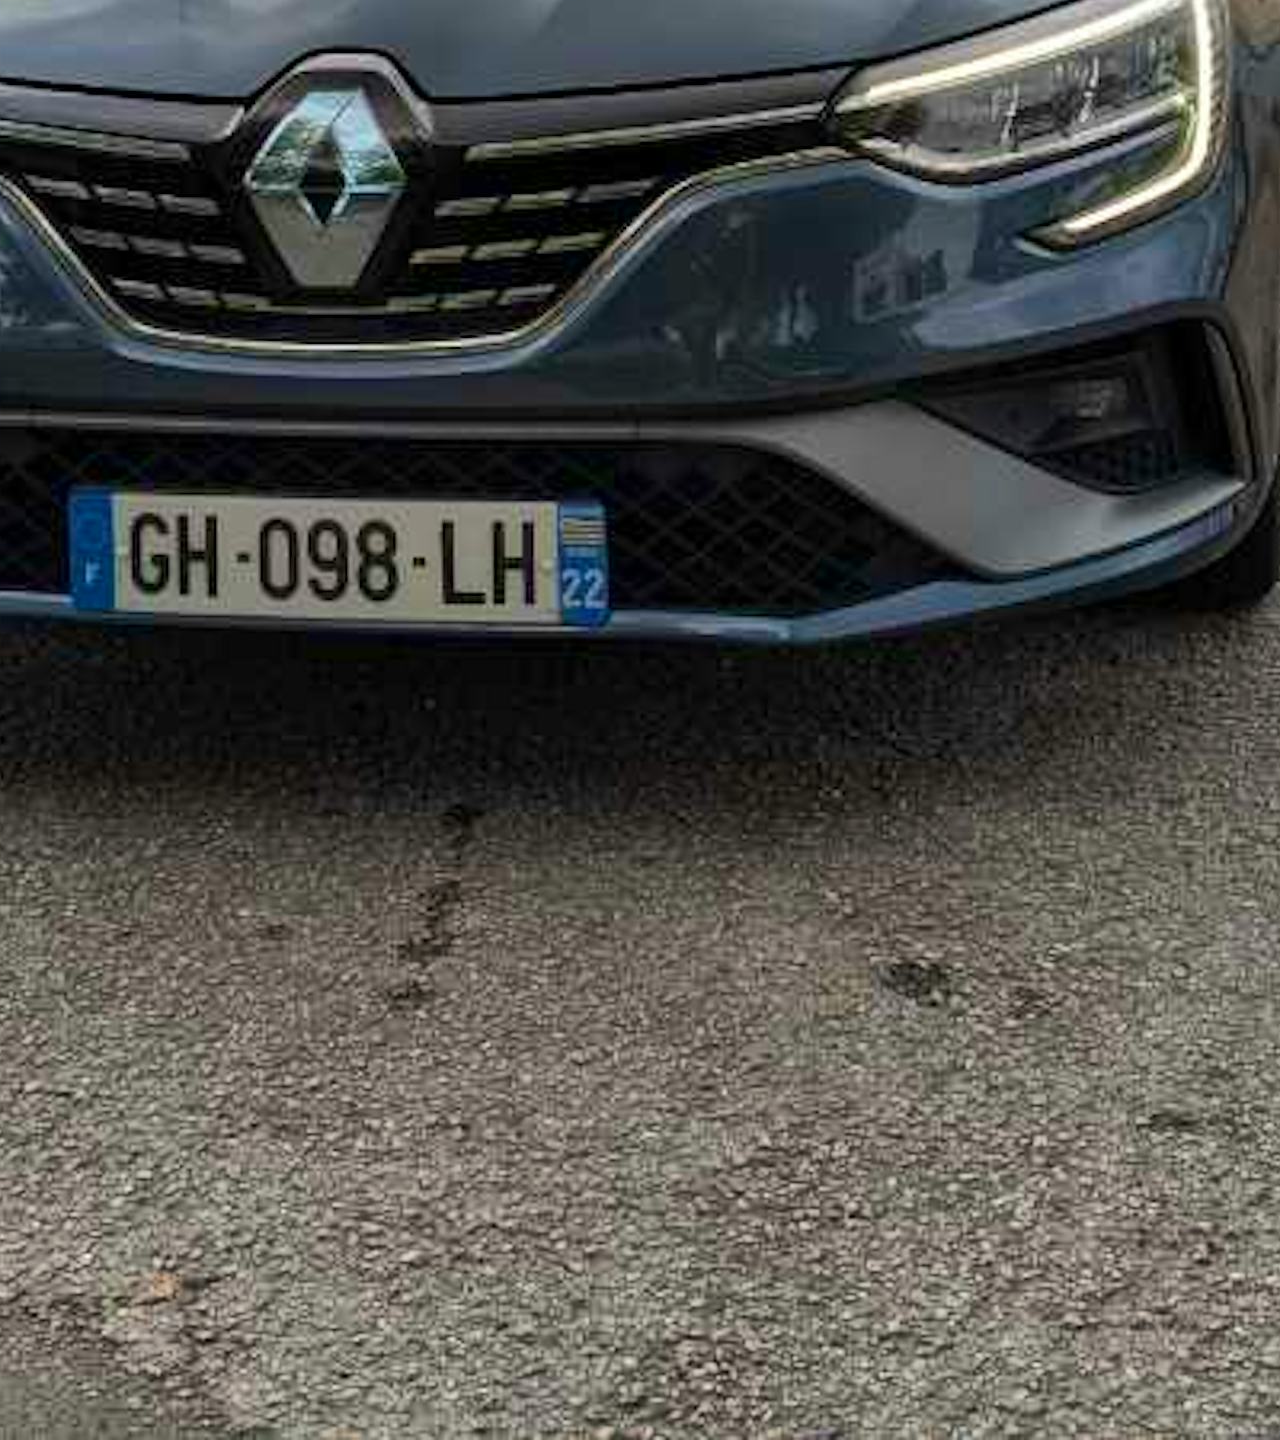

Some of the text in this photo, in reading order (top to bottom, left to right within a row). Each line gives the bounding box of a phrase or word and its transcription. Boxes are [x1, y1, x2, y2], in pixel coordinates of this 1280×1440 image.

[85, 562, 100, 584] F
[131, 513, 535, 605] GH-098-LH
[562, 568, 605, 609] 22
